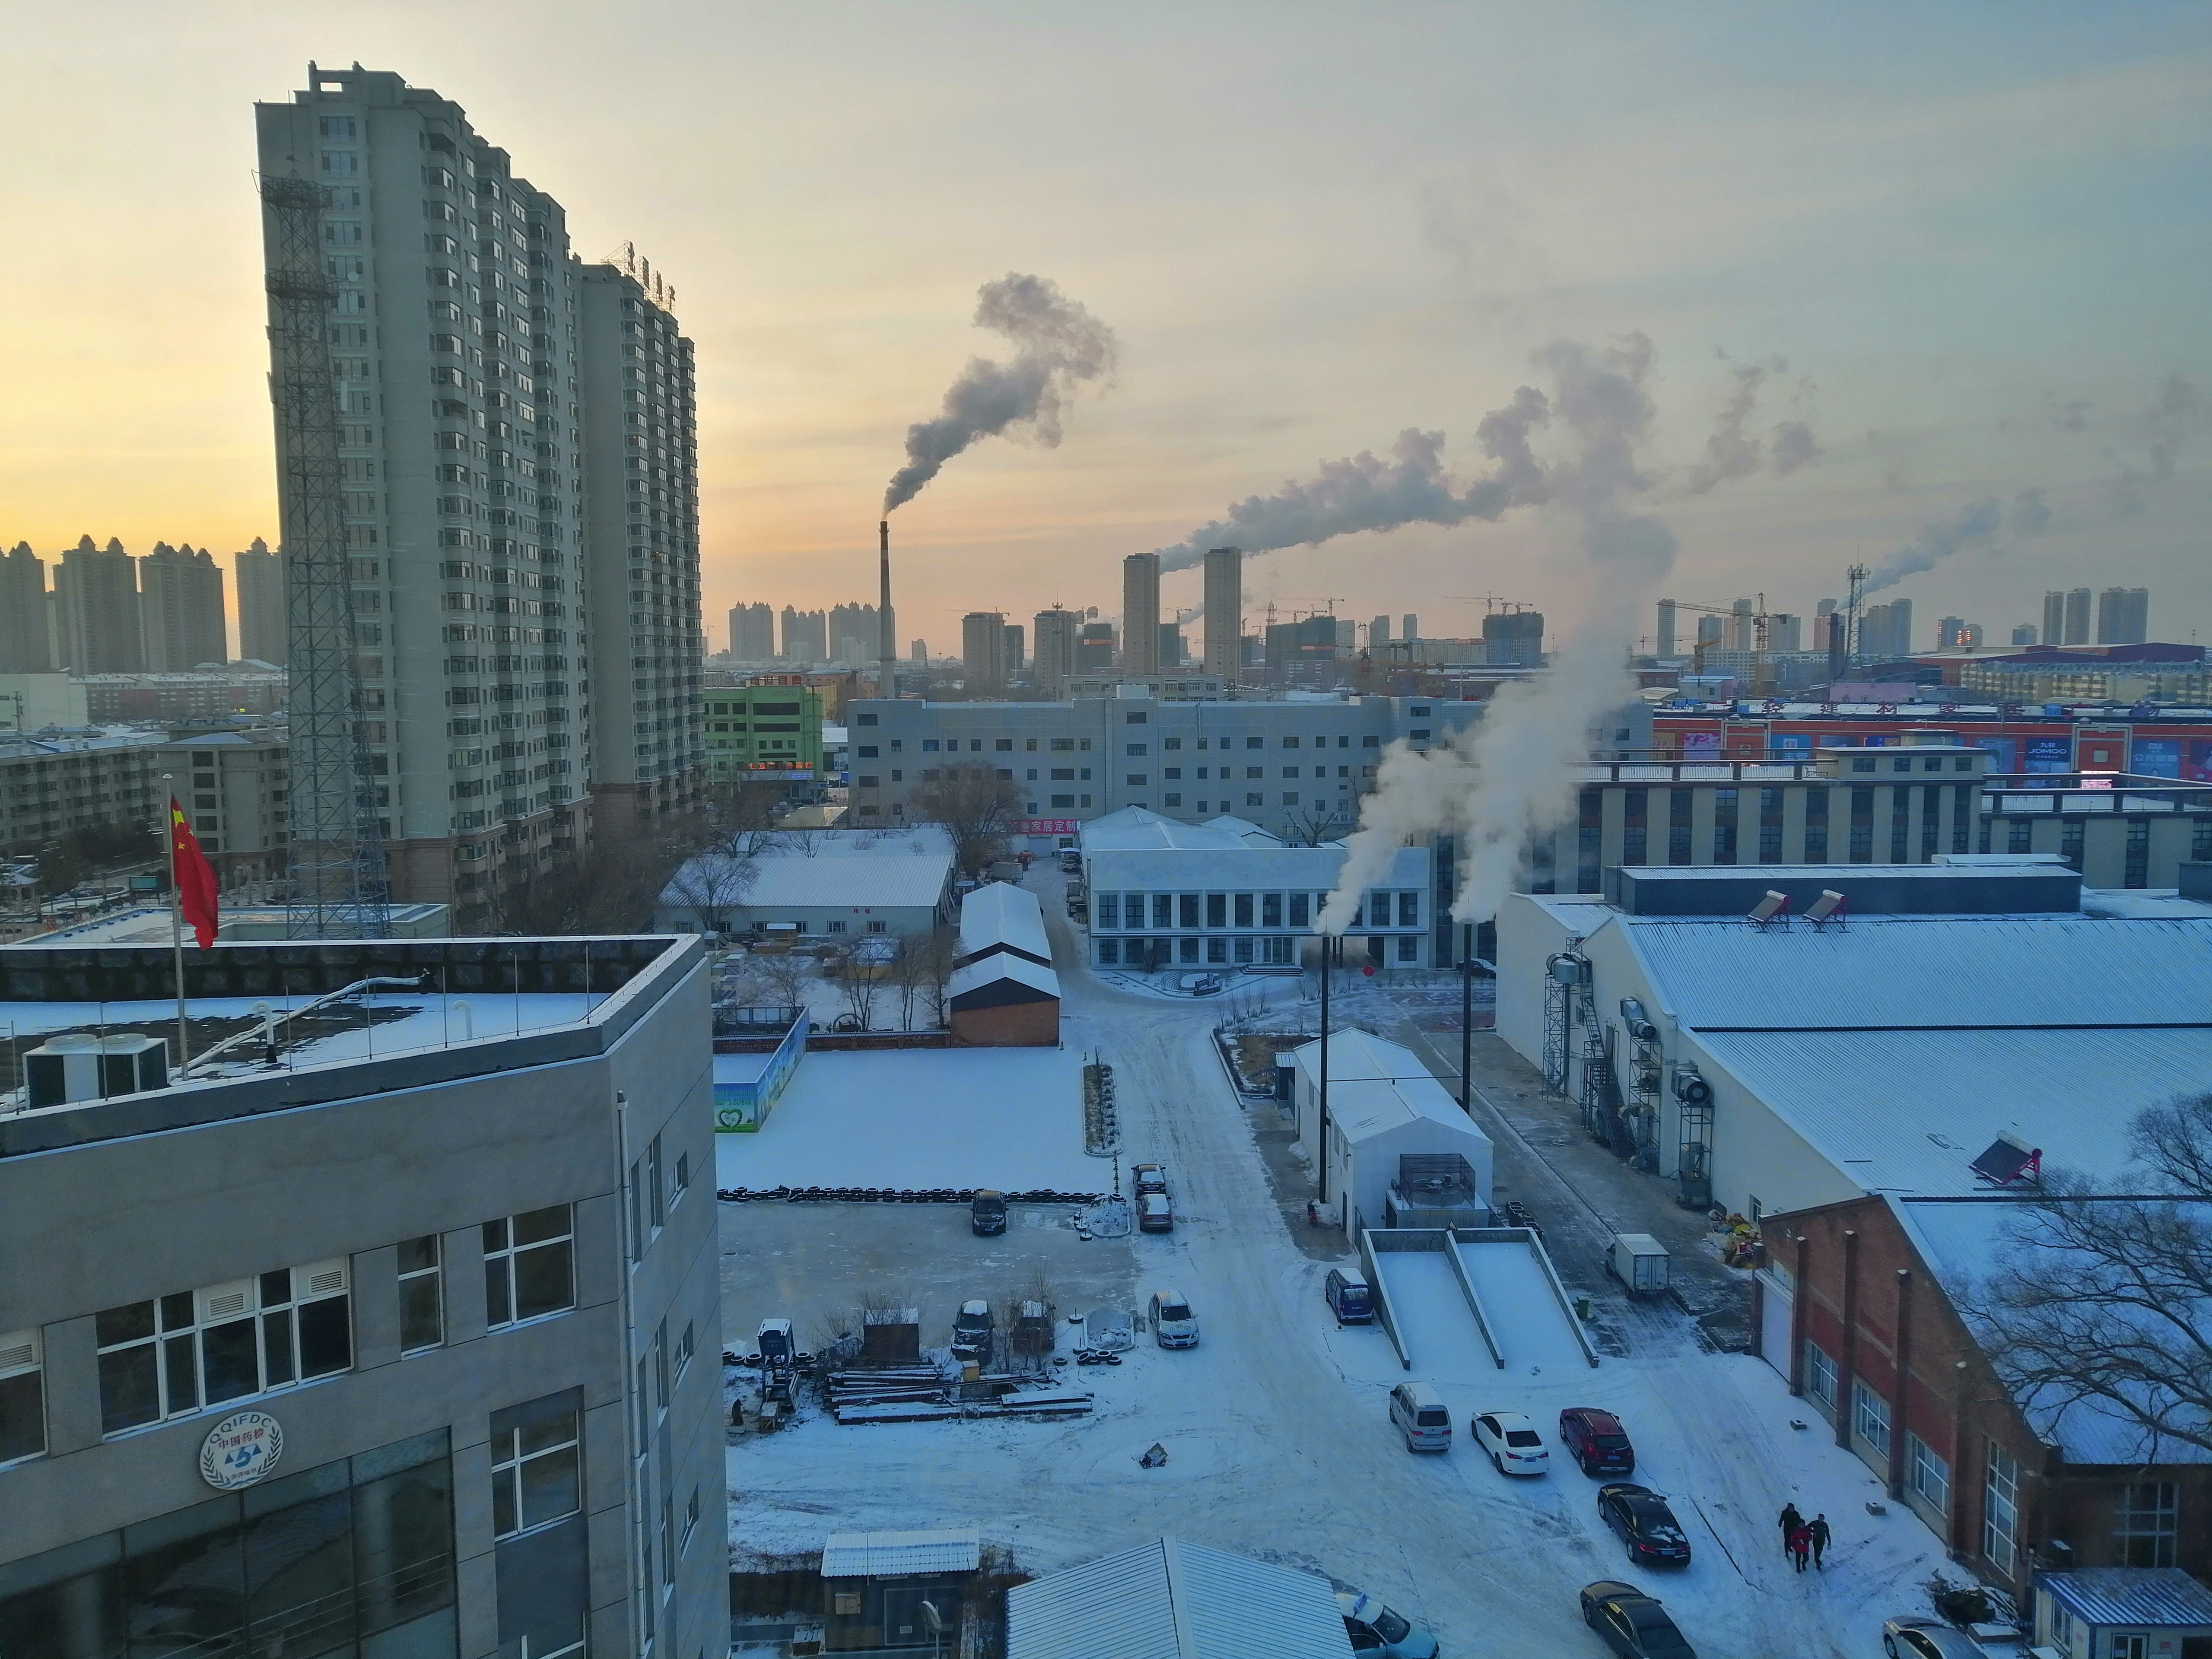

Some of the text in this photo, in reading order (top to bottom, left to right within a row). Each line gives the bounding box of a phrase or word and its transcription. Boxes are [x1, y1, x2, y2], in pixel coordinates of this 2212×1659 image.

[1008, 820, 1075, 833] 鲁家居定制
[210, 1414, 272, 1444] QQIFDC
[219, 1427, 264, 1449] 中国药检
